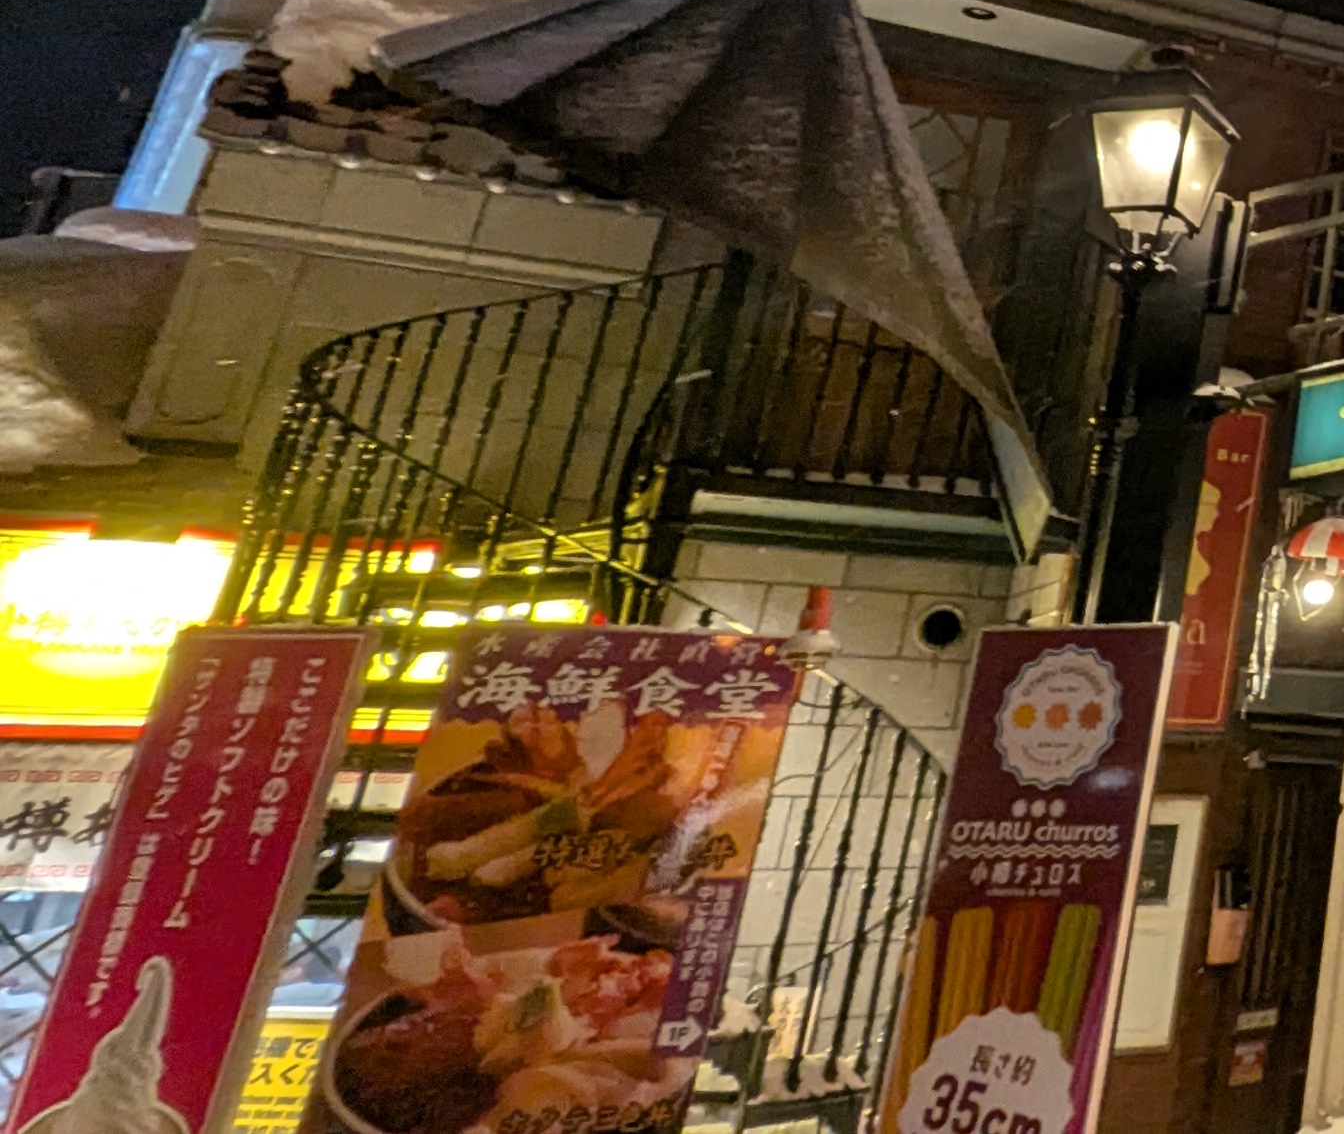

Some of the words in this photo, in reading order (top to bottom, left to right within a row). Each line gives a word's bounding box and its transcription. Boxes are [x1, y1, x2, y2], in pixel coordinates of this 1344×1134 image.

[1216, 448, 1250, 464] Bar
[456, 662, 782, 720] 海鮮食堂
[951, 821, 1032, 843] OTARU
[1034, 820, 1119, 843] churros
[922, 1072, 1043, 1134] 35cm
